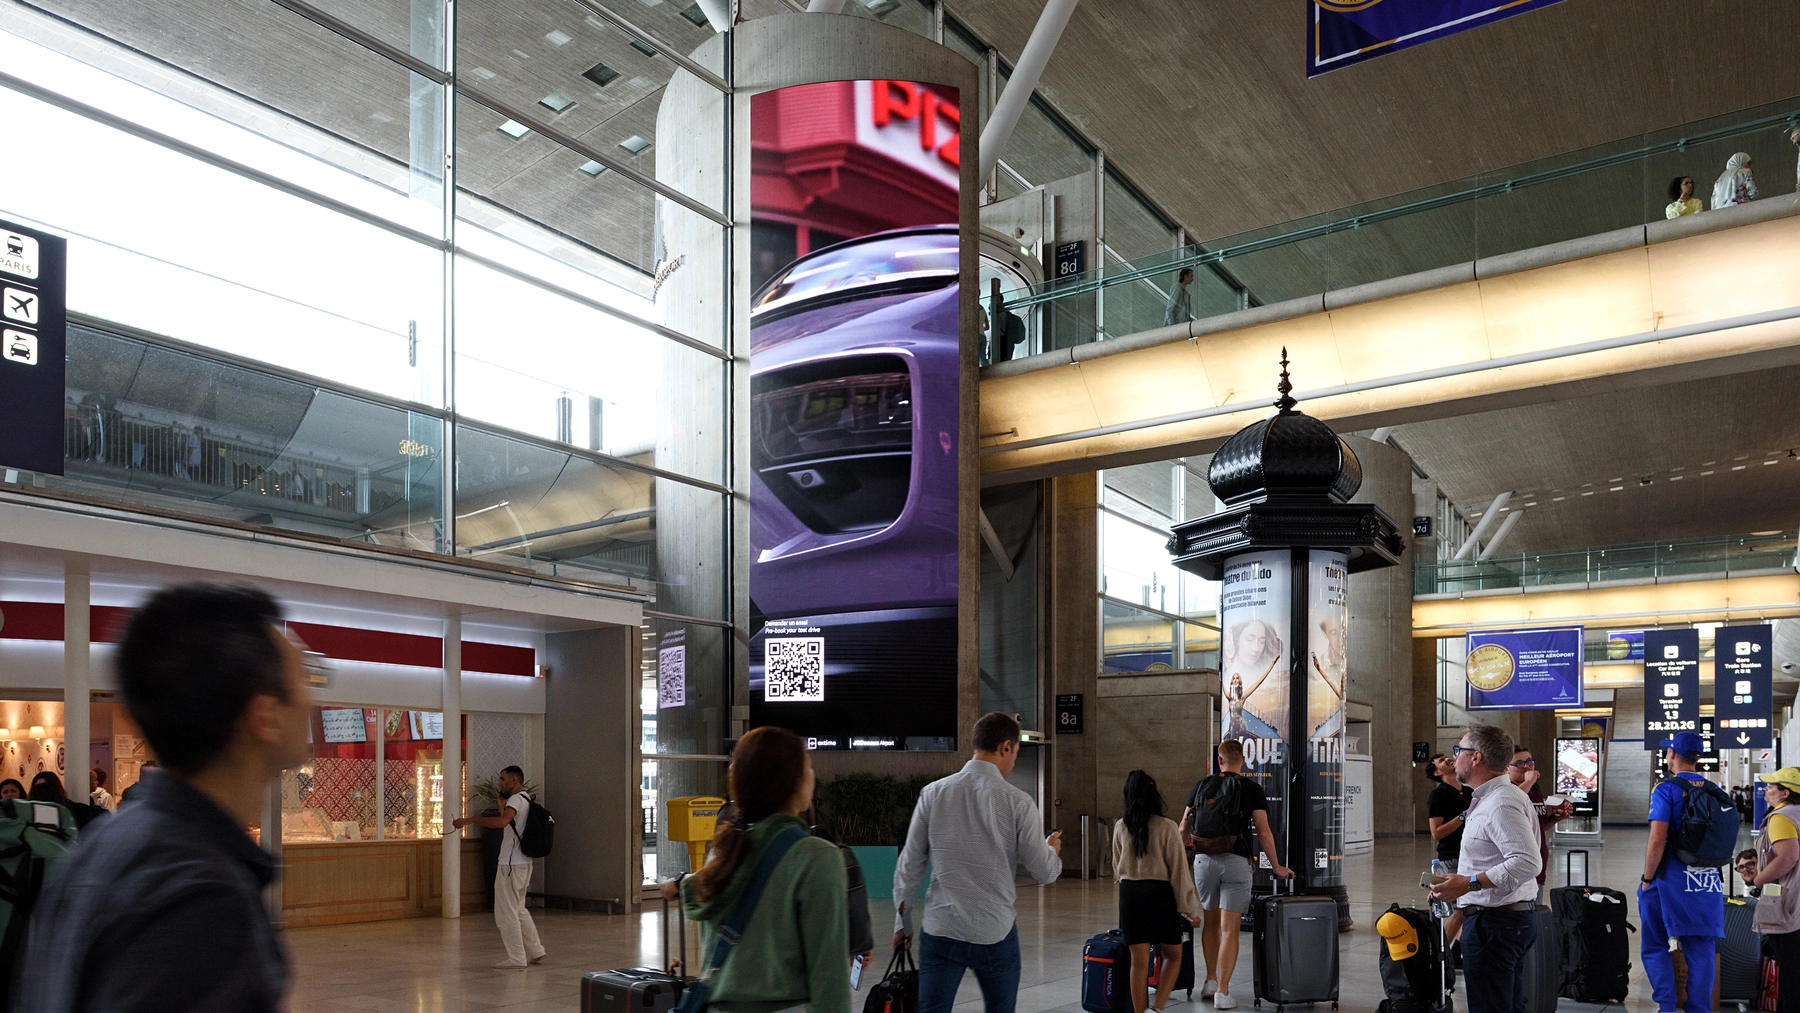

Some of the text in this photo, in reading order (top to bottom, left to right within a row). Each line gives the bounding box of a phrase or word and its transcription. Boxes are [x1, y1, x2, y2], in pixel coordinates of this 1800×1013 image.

[1060, 258, 1077, 275] 8d
[1416, 525, 1427, 533] 7d
[1241, 570, 1251, 581] du
[1484, 647, 1508, 659] AIRPORT
[1061, 712, 1077, 725] 8a
[1664, 710, 1679, 720] 1,3
[1648, 721, 1695, 731] 2B,2D,2G
[1345, 785, 1361, 795] FRENCH
